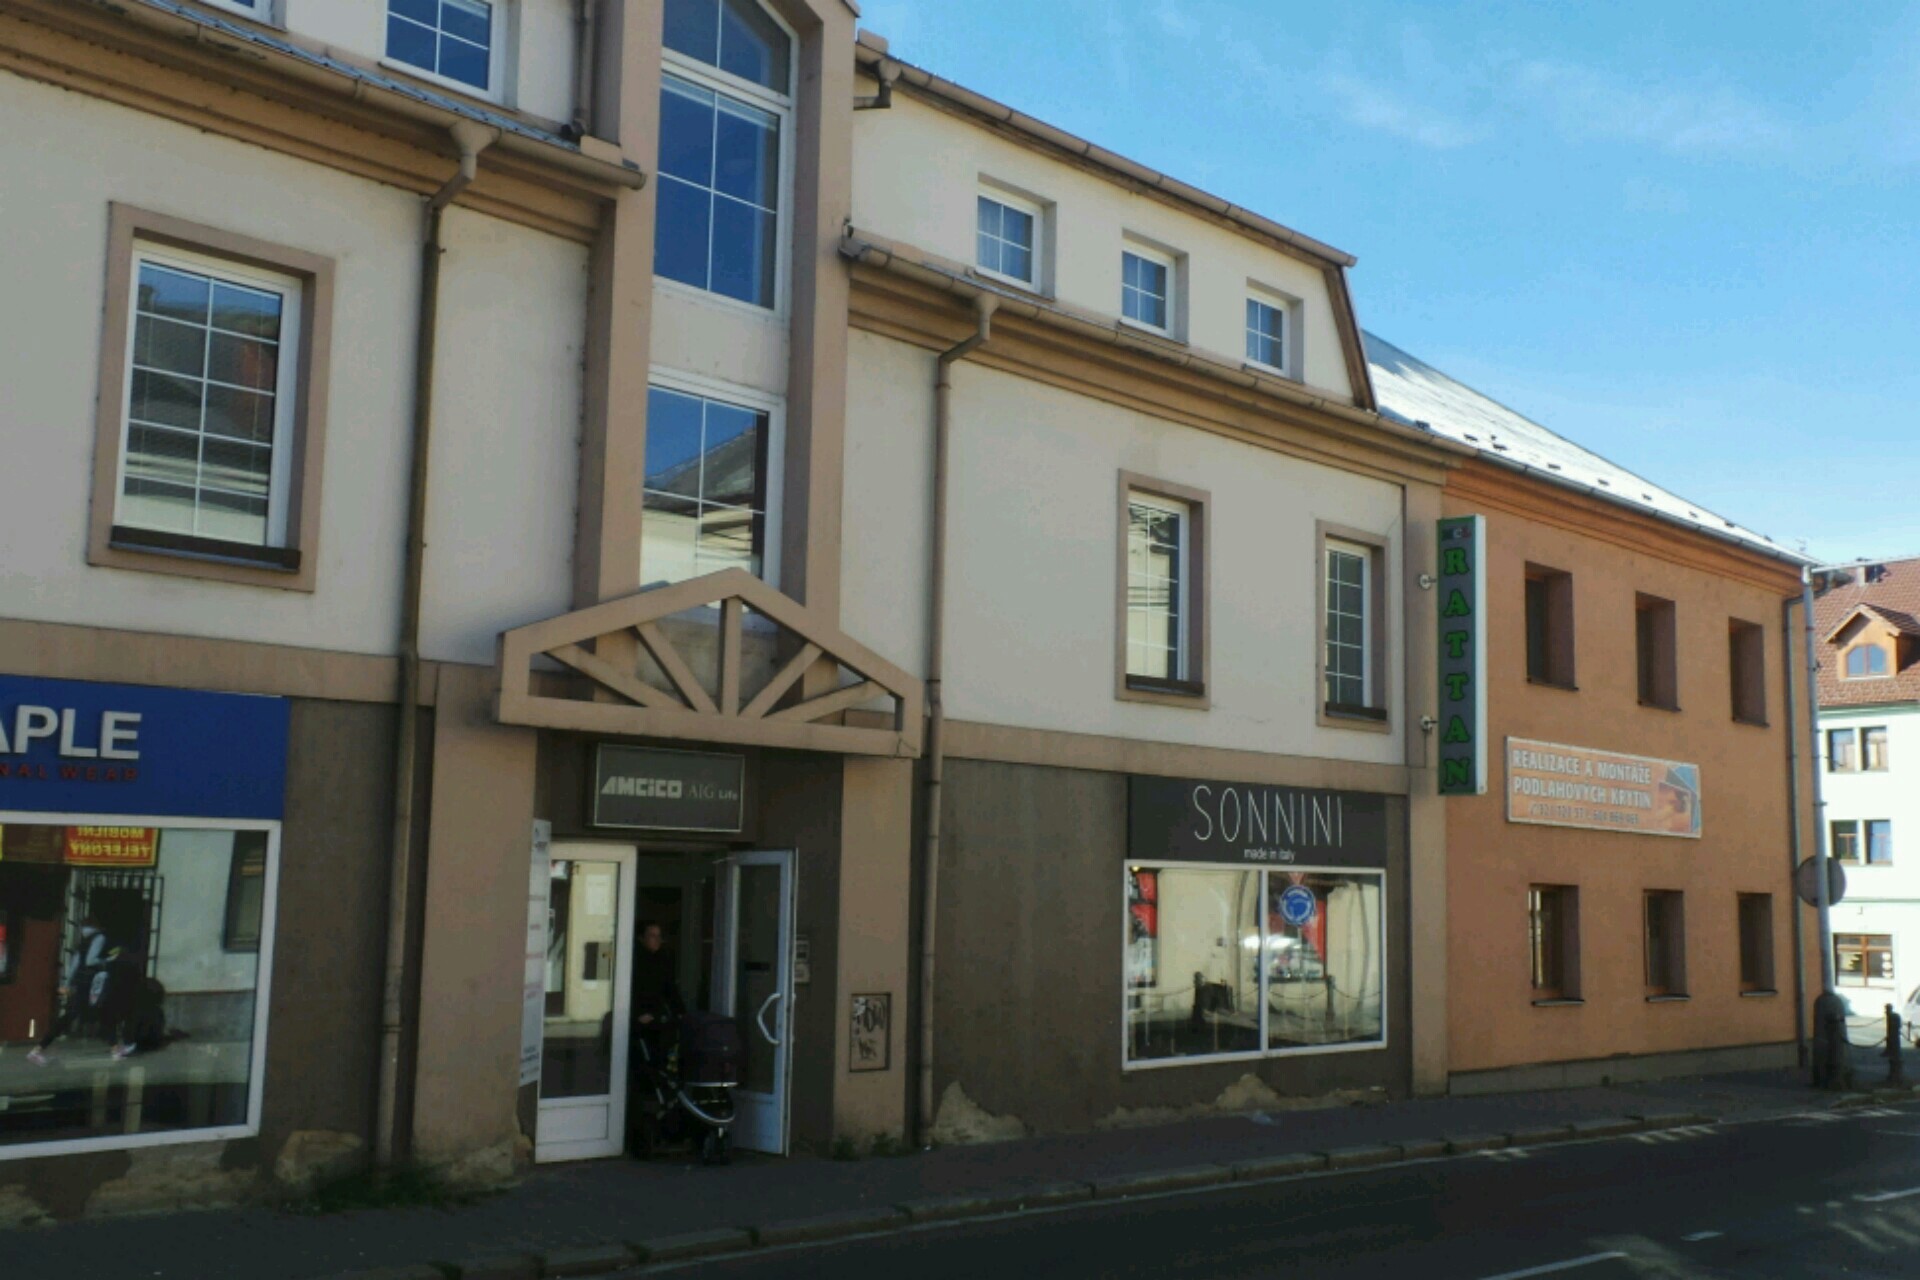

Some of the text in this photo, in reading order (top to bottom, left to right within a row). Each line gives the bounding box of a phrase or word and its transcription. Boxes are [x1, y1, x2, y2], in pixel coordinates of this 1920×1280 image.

[1444, 547, 1471, 786] RATTAN
[0, 704, 142, 760] PLE
[59, 764, 138, 781] WEAR
[1512, 749, 1580, 776] REALIZACE
[1584, 760, 1593, 777] A
[688, 783, 714, 799] AIG
[718, 789, 738, 801] Life
[1611, 788, 1651, 809] KRYTIN
[1192, 784, 1342, 848] SONNINI
[1244, 848, 1267, 860] made
[1269, 848, 1277, 860] in
